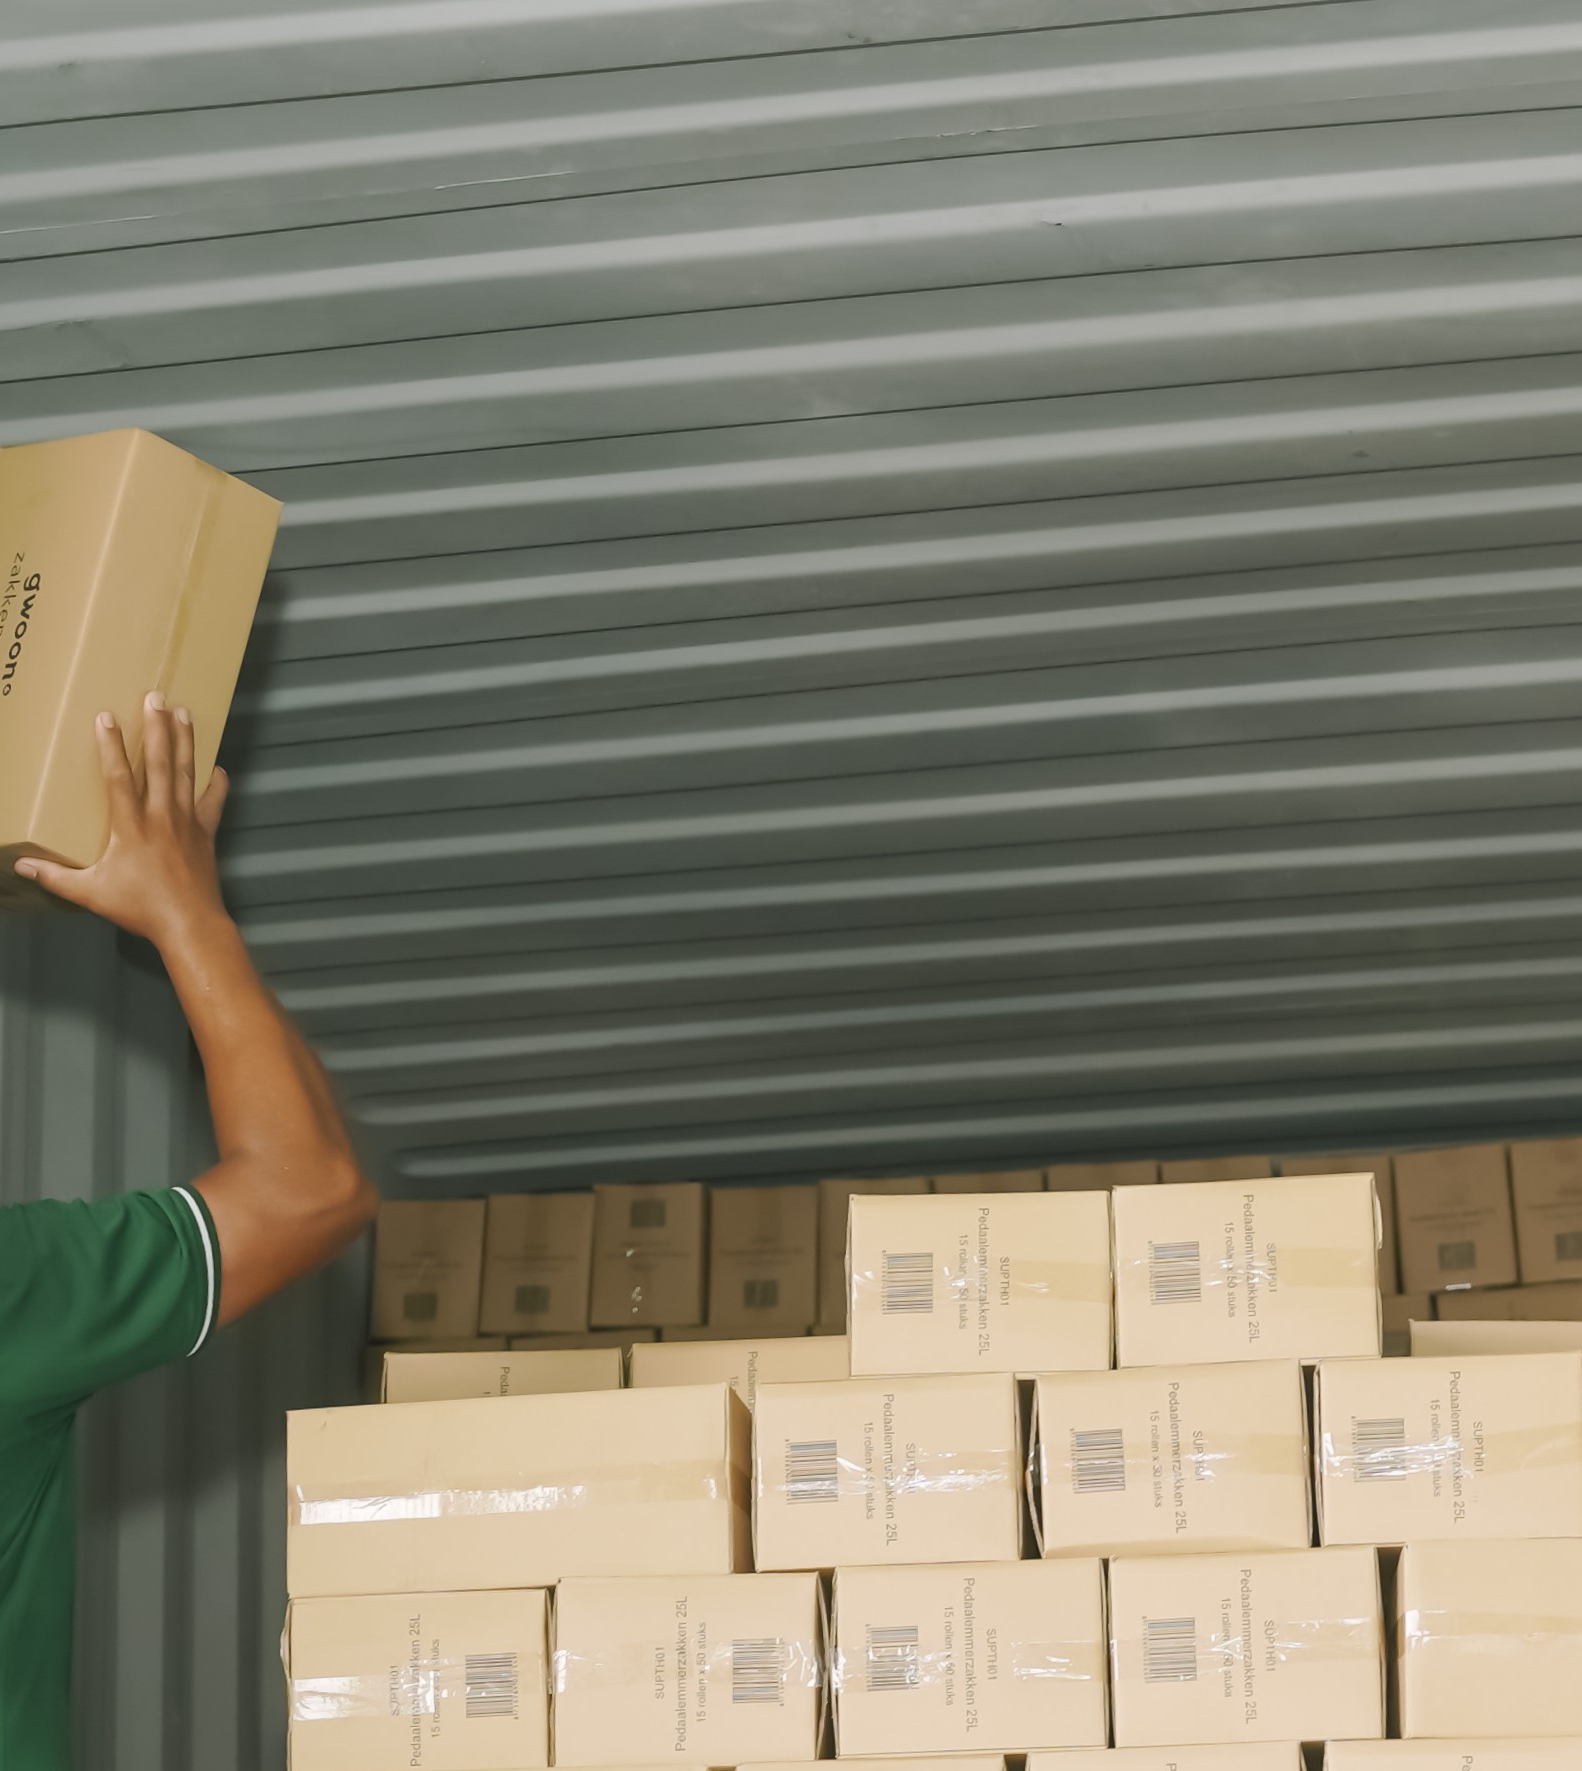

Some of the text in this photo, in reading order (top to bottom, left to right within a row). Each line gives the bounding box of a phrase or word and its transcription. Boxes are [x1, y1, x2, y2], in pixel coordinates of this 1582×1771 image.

[959, 1234, 969, 1331] 15 stuks
[1225, 1222, 1237, 1319] 15 stuks
[979, 1334, 990, 1357] 25L
[1248, 1321, 1260, 1345] 25L
[864, 1422, 874, 1466] 15 rollen
[1150, 1410, 1163, 1509] 15 rollen stuks
[1431, 1399, 1442, 1498] 15 rollen stuks
[1473, 1420, 1483, 1473] SUPTH01
[886, 1524, 897, 1548] 25L
[1174, 1512, 1186, 1535] 25L
[1453, 1501, 1465, 1525] 25L
[410, 1613, 421, 1636] 25L
[1221, 1598, 1233, 1699] 15 stuks
[1241, 1569, 1257, 1725] Pedaalemmerzakken 25L
[654, 1646, 665, 1700] SUPTH01
[675, 1595, 687, 1752] Pedaalemmerzakken 25L
[696, 1621, 706, 1723] 15 rollen 50 stuks
[944, 1606, 955, 1707] 15 rollen stuks
[964, 1577, 977, 1733] Pedaalemmerzakken 25L
[986, 1628, 997, 1681] SUPTH01
[431, 1725, 441, 1738] 15
